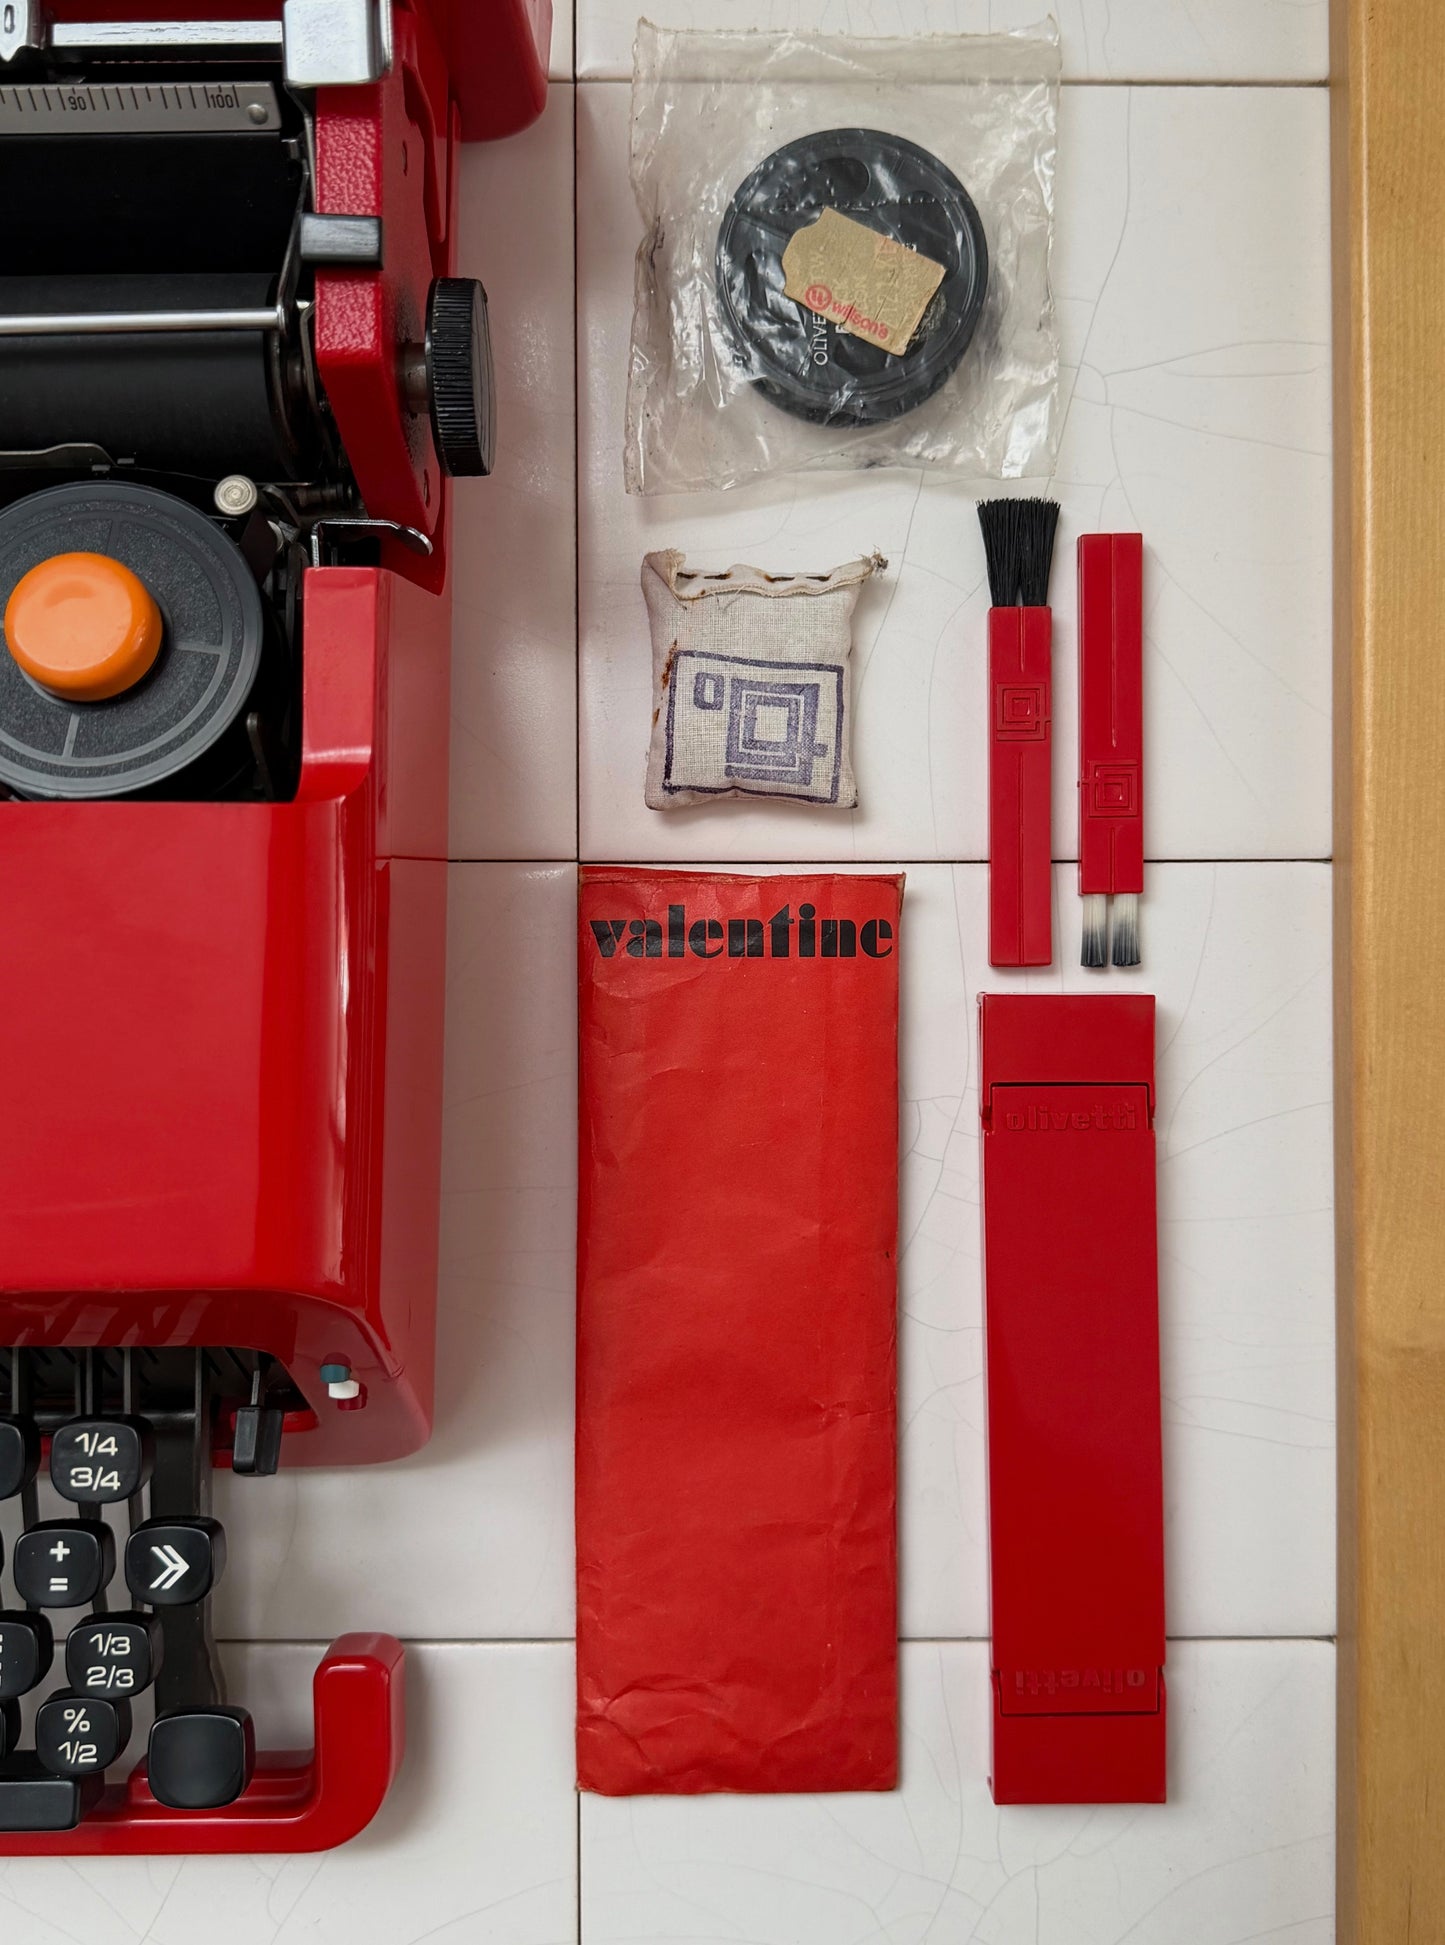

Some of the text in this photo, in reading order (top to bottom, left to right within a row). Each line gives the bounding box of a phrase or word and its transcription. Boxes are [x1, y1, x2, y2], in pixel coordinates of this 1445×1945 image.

[68, 94, 234, 111] 90 100
[812, 311, 829, 366] OLIVE
[590, 903, 893, 958] valentine
[1006, 1104, 1137, 1131] olivetti
[74, 1432, 119, 1457] 1/4
[70, 1466, 121, 1491] 3/4
[89, 1632, 131, 1656] 1/3
[86, 1665, 135, 1689] 2/3
[1016, 1668, 1146, 1695] olivetti
[63, 1708, 91, 1733] %
[58, 1741, 98, 1764] 1/2
